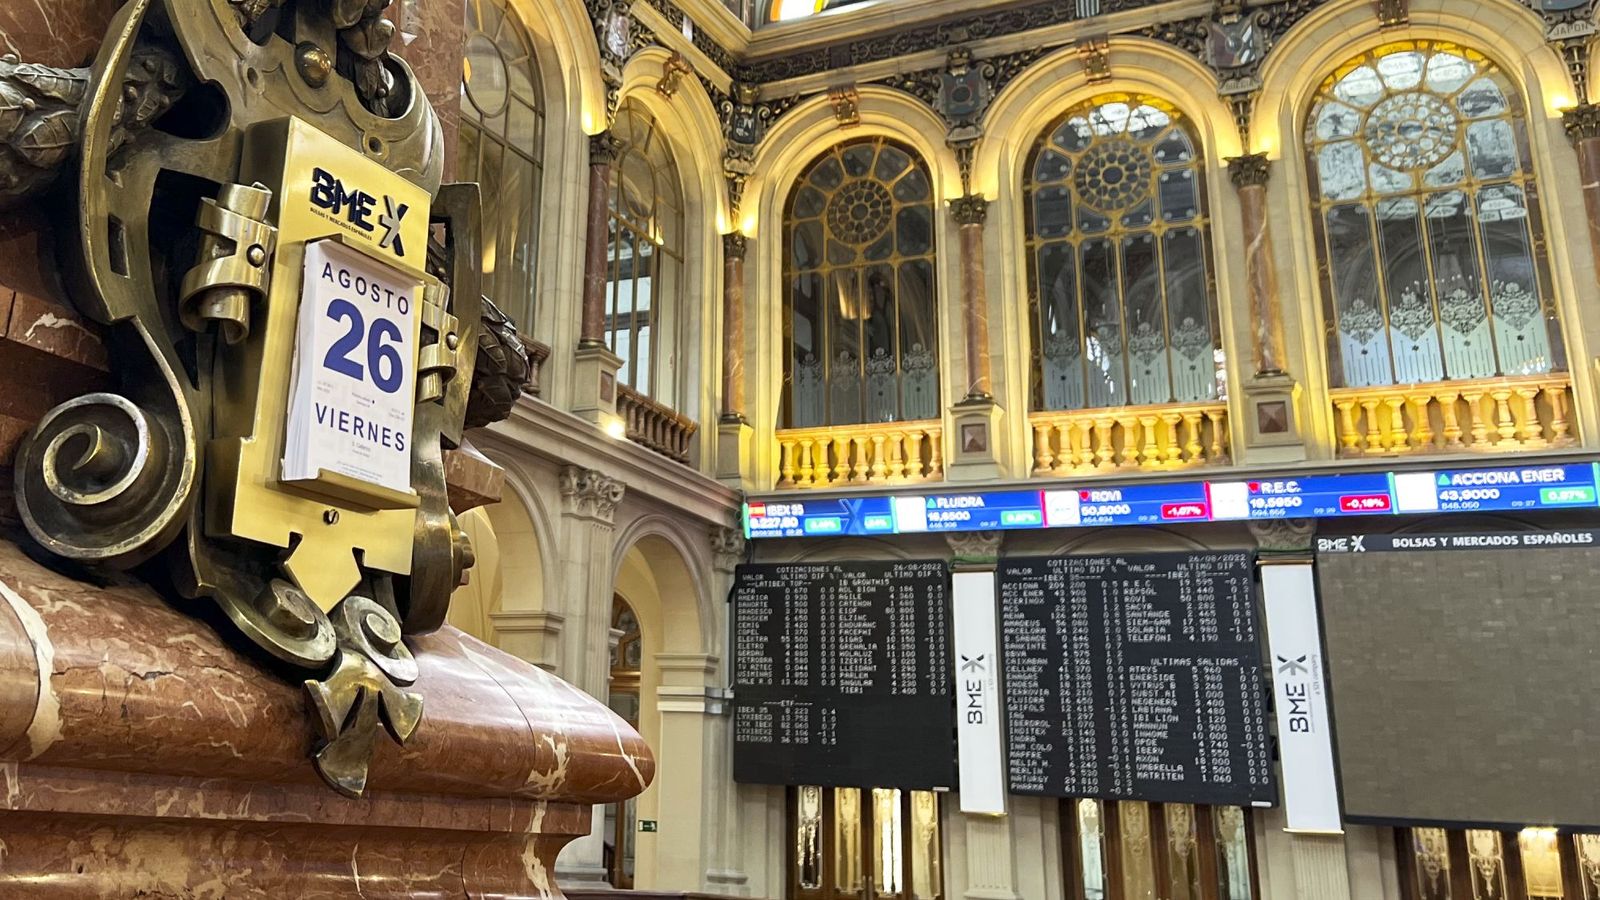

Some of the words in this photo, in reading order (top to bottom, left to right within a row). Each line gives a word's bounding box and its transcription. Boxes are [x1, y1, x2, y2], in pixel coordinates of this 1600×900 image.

[310, 168, 376, 232] BME
[321, 262, 409, 315] AGOSTO
[323, 298, 404, 394] 26
[315, 401, 405, 452] VIERNES
[1451, 471, 1519, 486] ACCIONA
[1521, 468, 1565, 483] ENER
[1091, 490, 1122, 502] ROVI
[1261, 481, 1302, 494] R.E.C.
[1439, 488, 1500, 501] 43,9000
[766, 504, 790, 516] IBEX
[937, 496, 985, 508] FLUIDRA
[1317, 538, 1348, 552] BME
[1392, 537, 1436, 548] BOLSAS
[1440, 537, 1448, 547] Y
[1453, 535, 1518, 547] MERCADOS
[1523, 532, 1593, 545] ESPAÑOLES
[967, 680, 983, 724] BME
[1286, 683, 1309, 732] BME
